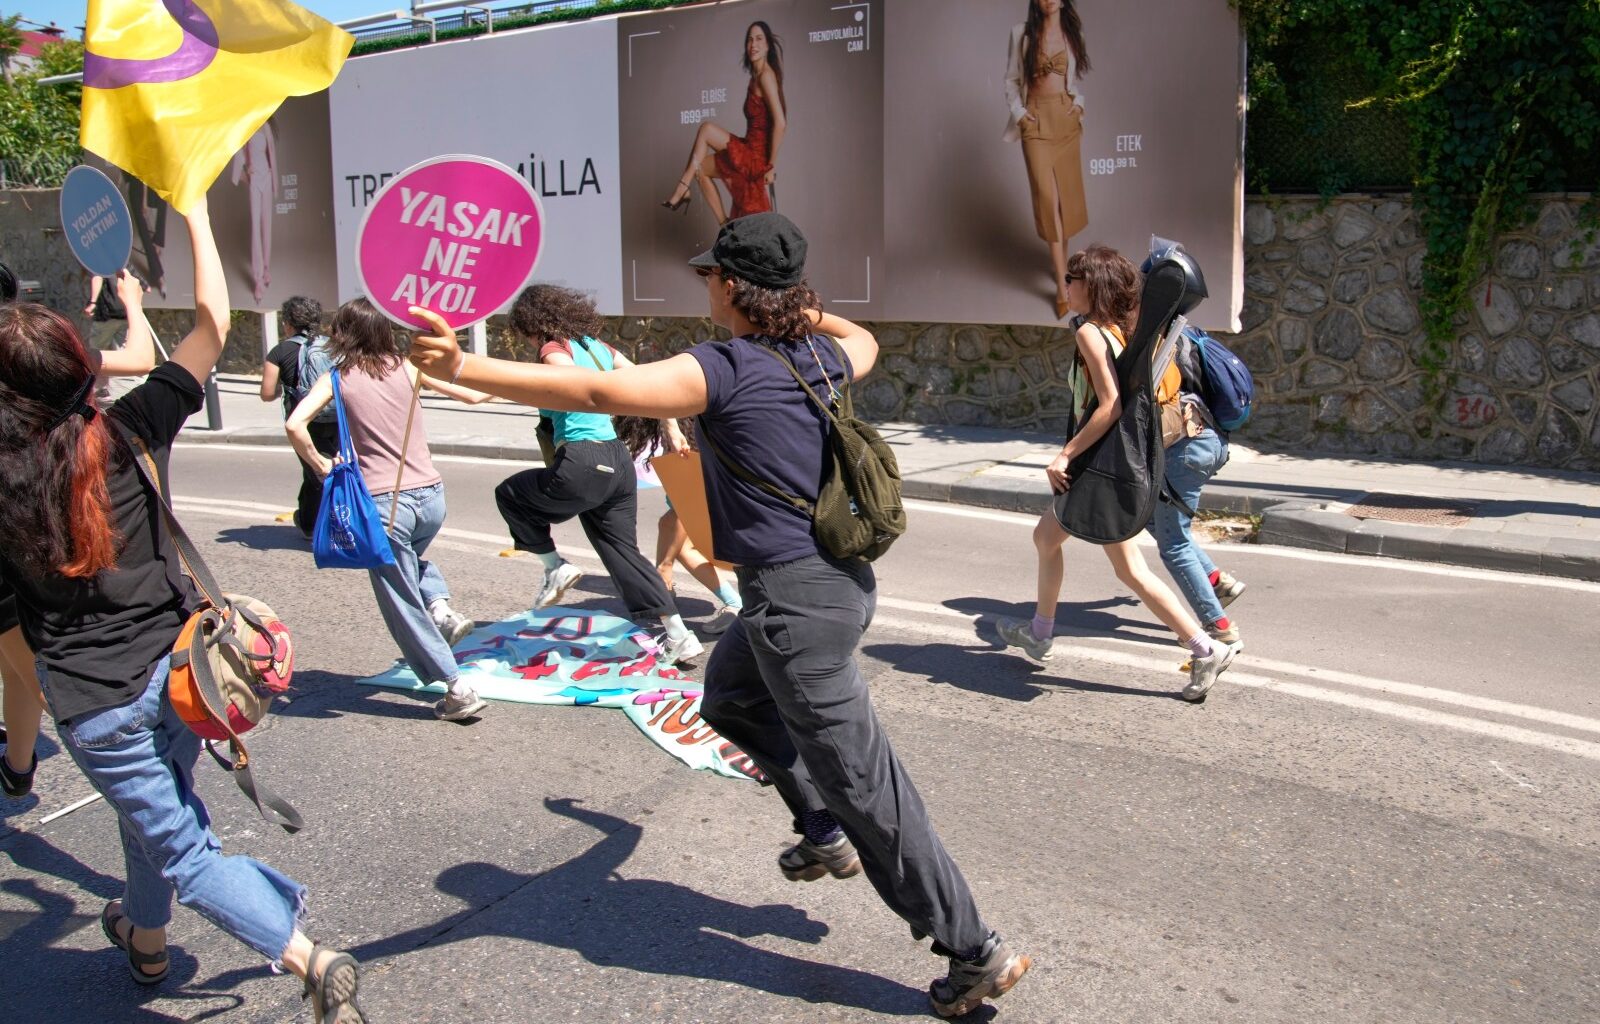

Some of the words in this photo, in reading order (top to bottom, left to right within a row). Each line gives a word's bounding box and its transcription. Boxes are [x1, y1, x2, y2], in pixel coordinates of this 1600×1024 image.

[847, 40, 864, 52] CAM
[701, 87, 727, 104] ELBİSE
[1116, 134, 1142, 152] ETEK
[1128, 157, 1138, 168] TL
[71, 194, 112, 233] YOLDAN
[400, 187, 533, 247] YASAK
[421, 237, 482, 280] NE
[390, 273, 477, 314] AYOL
